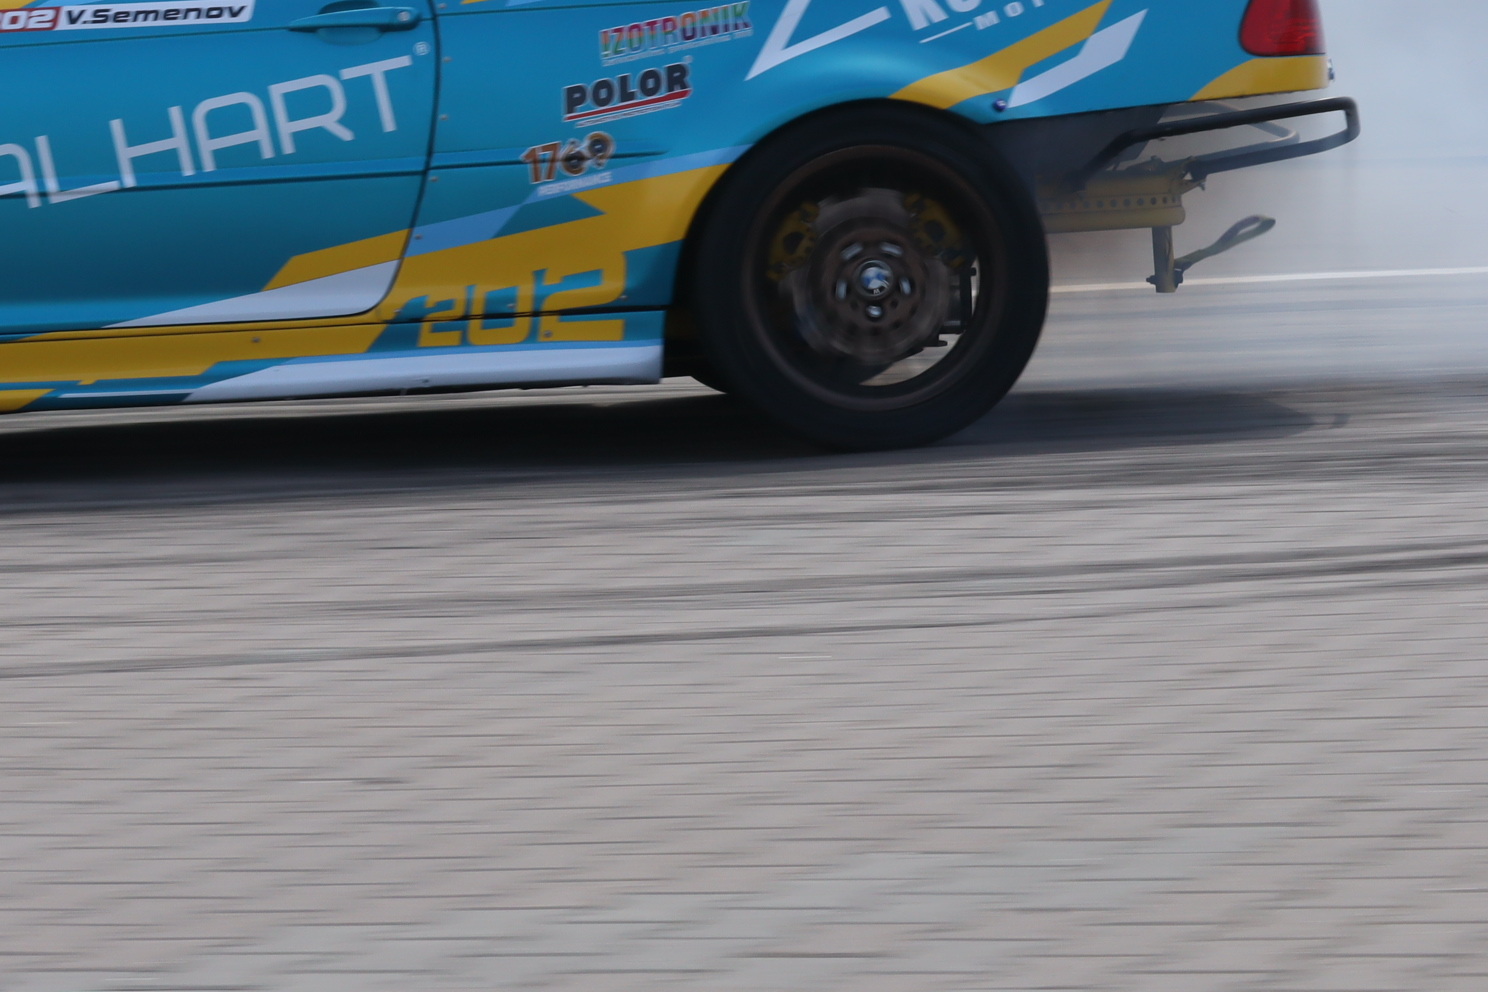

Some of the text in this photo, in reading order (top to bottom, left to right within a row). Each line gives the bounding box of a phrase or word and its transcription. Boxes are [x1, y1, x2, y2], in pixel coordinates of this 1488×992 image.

[66, 4, 247, 26] V.Semenov
[563, 62, 691, 116] POLOR
[417, 252, 627, 348] 202
